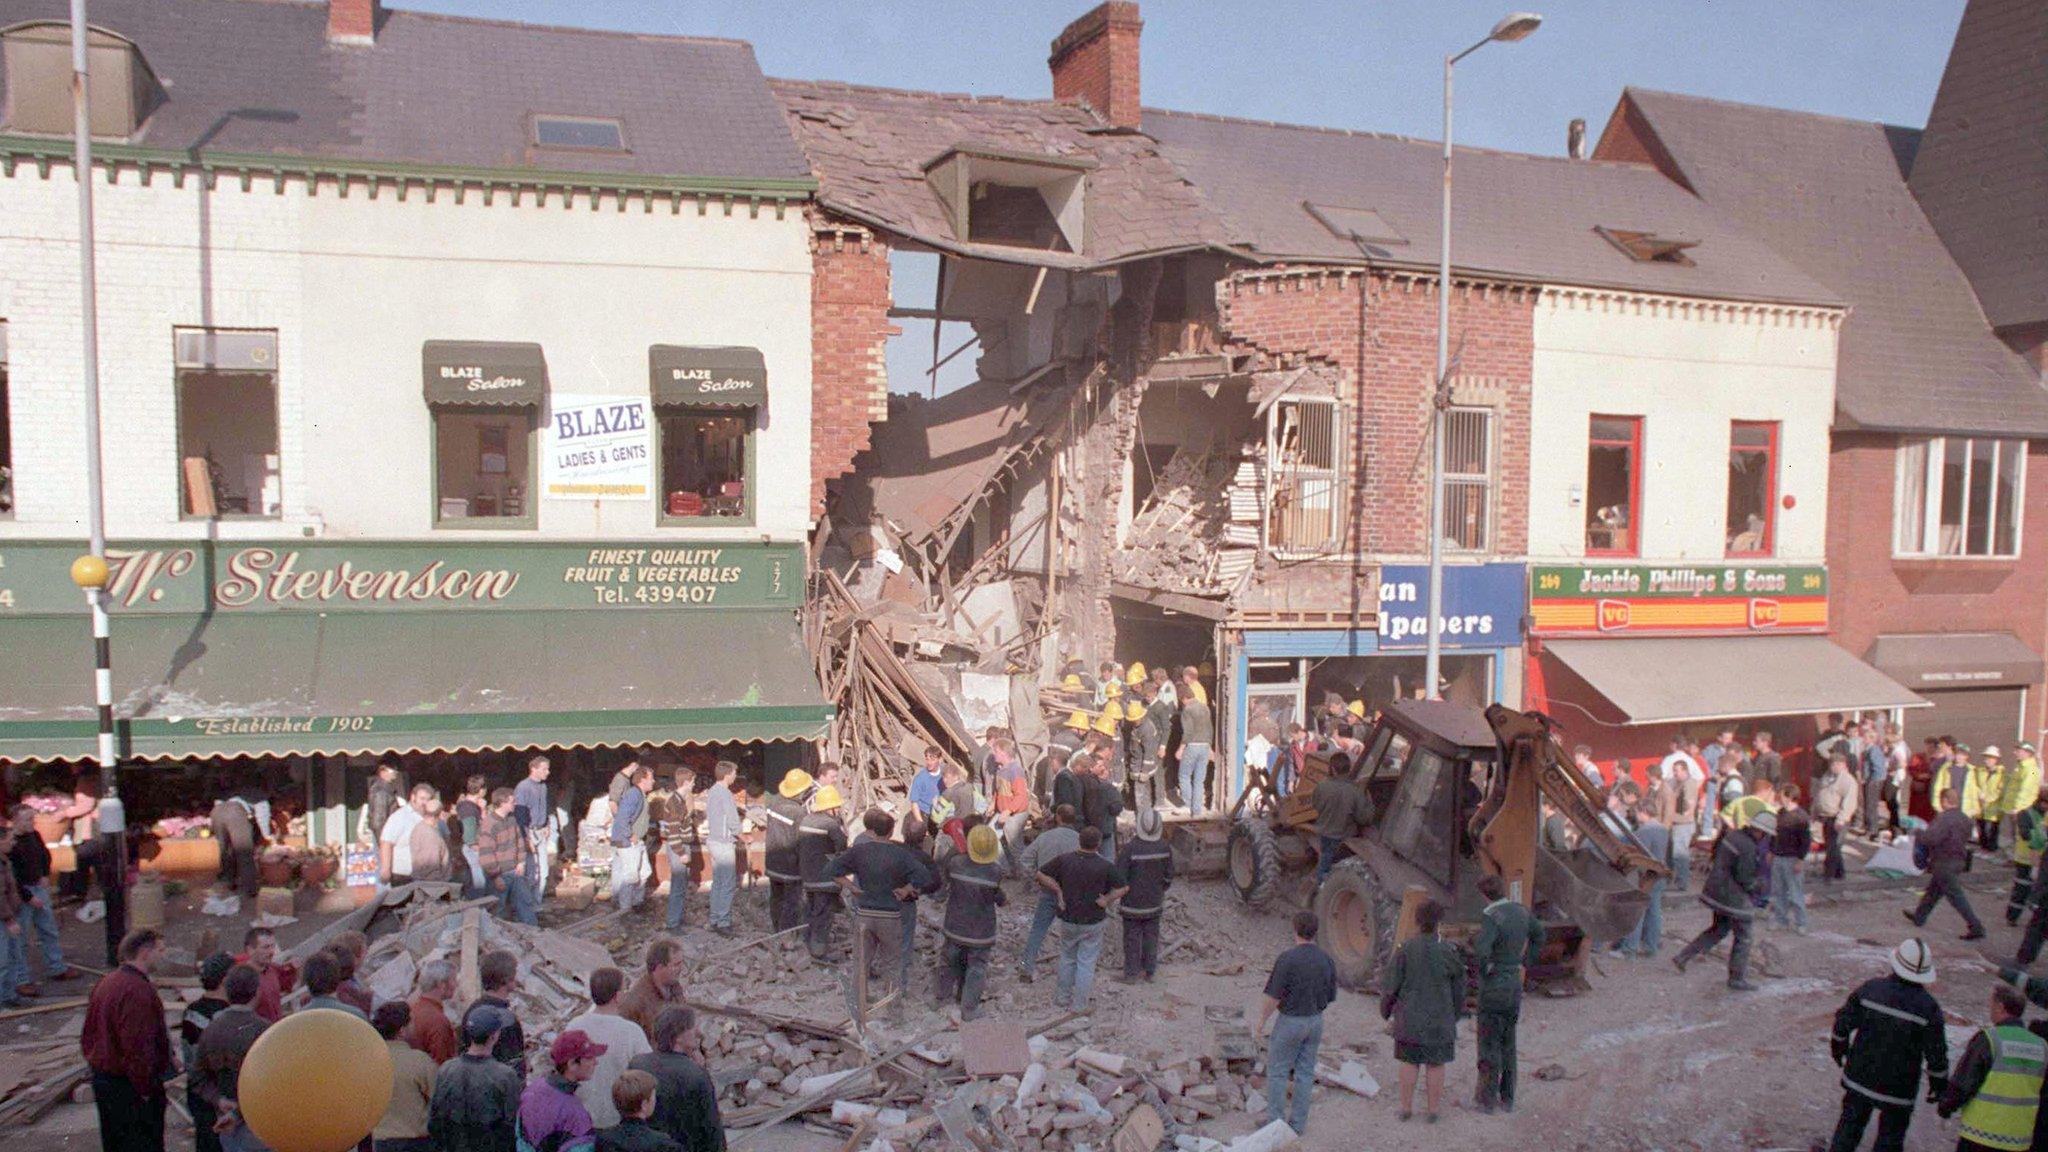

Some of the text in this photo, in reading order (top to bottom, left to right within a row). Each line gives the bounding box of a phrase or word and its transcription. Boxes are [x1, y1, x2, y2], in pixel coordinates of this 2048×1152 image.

[441, 367, 482, 378] BLAZE
[672, 369, 711, 380] BLAZE
[467, 376, 526, 391] Salon
[698, 378, 754, 393] Salon
[555, 403, 645, 440] BLAZE
[558, 444, 646, 469] LADIES & GENTS
[587, 549, 723, 566] FINEST QUALITY
[215, 547, 521, 606] Stevenson
[564, 566, 742, 583] FRUIT & VEGETABLES
[1540, 573, 1561, 590] 269
[1578, 569, 1641, 593] Jackie
[1648, 569, 1716, 597] Phillips
[1723, 569, 1737, 592] &
[1743, 569, 1786, 592] Sons
[593, 585, 717, 603] Tel. 439407
[1604, 608, 1628, 622] VG
[1756, 606, 1778, 620] VG
[329, 715, 375, 732] 1902
